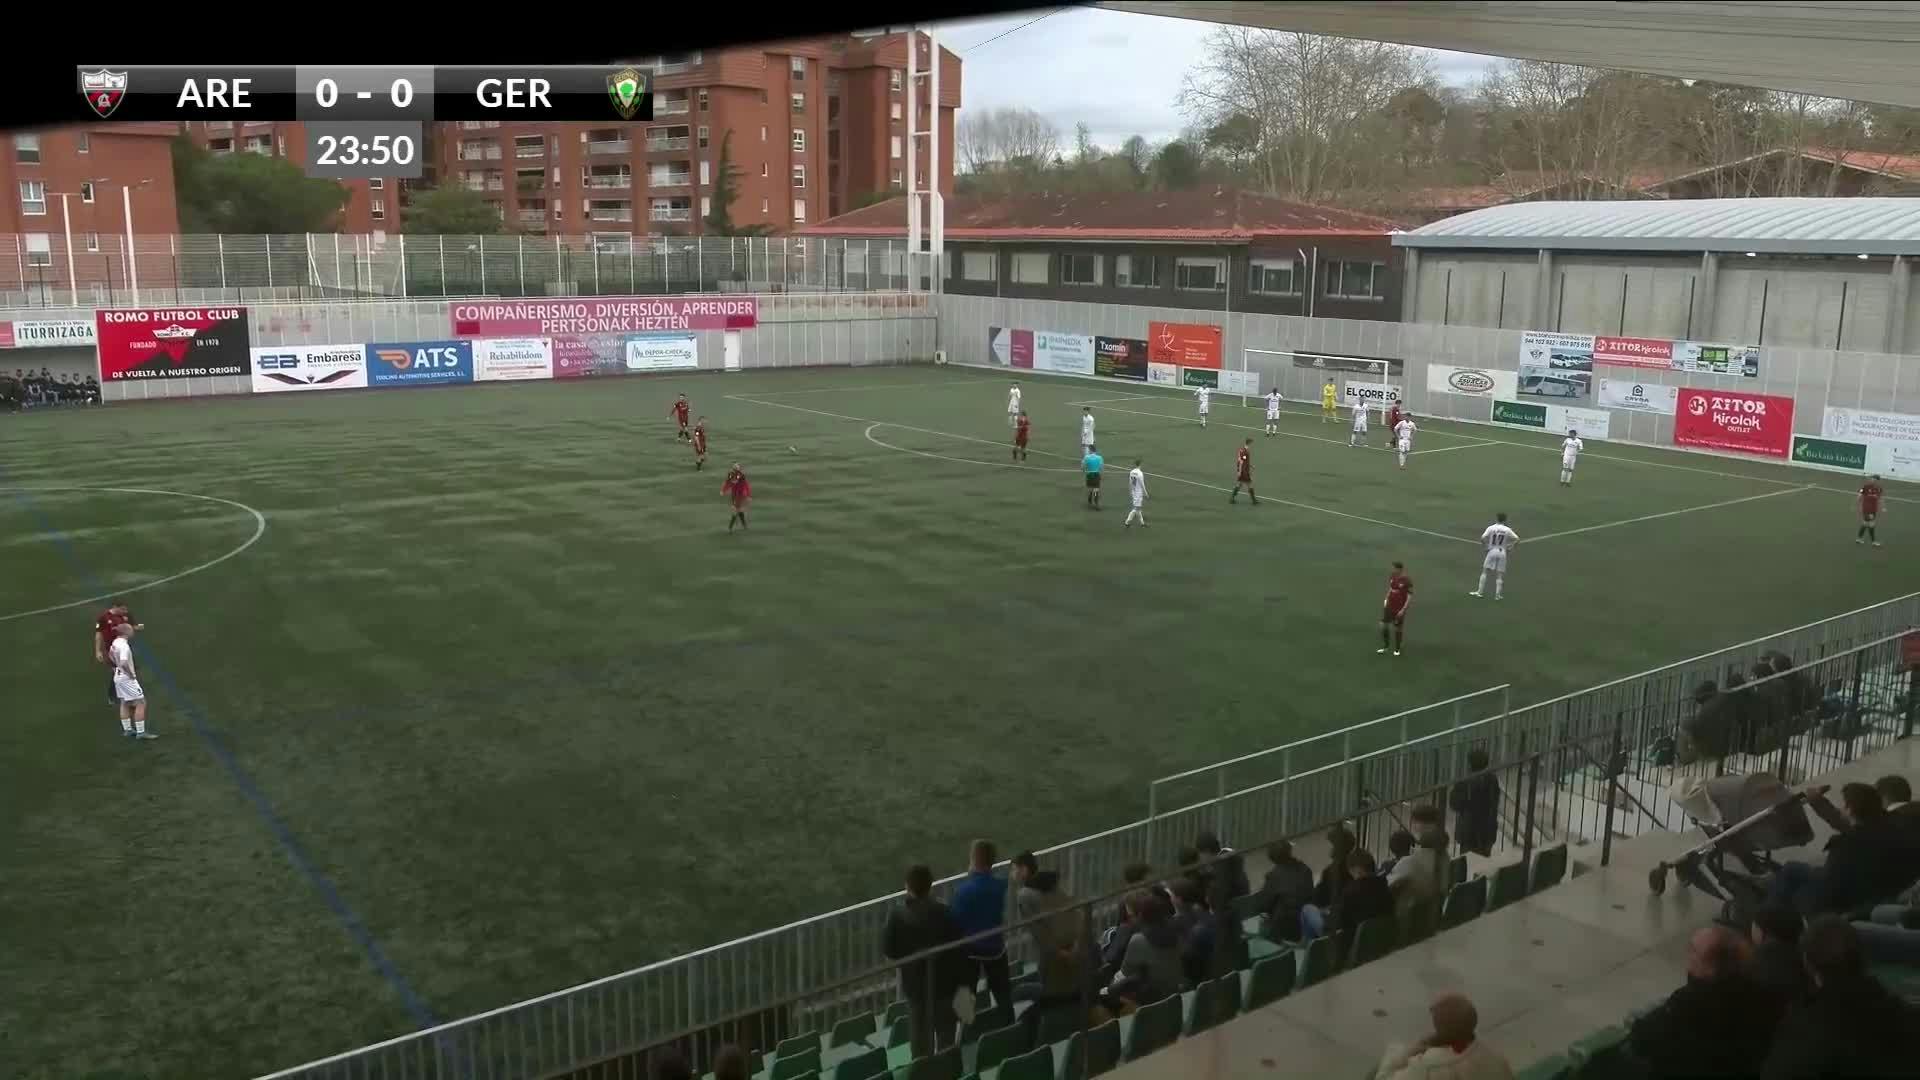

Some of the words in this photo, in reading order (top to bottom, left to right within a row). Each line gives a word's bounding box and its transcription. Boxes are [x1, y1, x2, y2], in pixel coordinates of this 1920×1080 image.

[104, 311, 149, 323] ROMO
[153, 310, 204, 322] FUTBOL
[206, 309, 239, 320] CLUB
[455, 303, 592, 321] COMPAÑERISMO,
[596, 300, 678, 317] DIVERSIÓN,
[682, 302, 753, 316] APRENDER
[18, 326, 93, 339] ITURRIZAGA
[541, 318, 631, 333] PERTSONAK
[1608, 341, 1640, 352] AITOR
[306, 352, 362, 363] Embaresa
[414, 347, 458, 369] ATS
[112, 371, 124, 379] DE
[126, 369, 157, 378] VUELTA
[159, 369, 166, 377] A
[168, 367, 207, 376] NUESTRO
[209, 366, 241, 375] ORIGEN
[1346, 387, 1358, 397] EL
[1358, 388, 1397, 401] CORREO
[1713, 411, 1761, 431] kirolak
[1727, 425, 1751, 433] OUTLET
